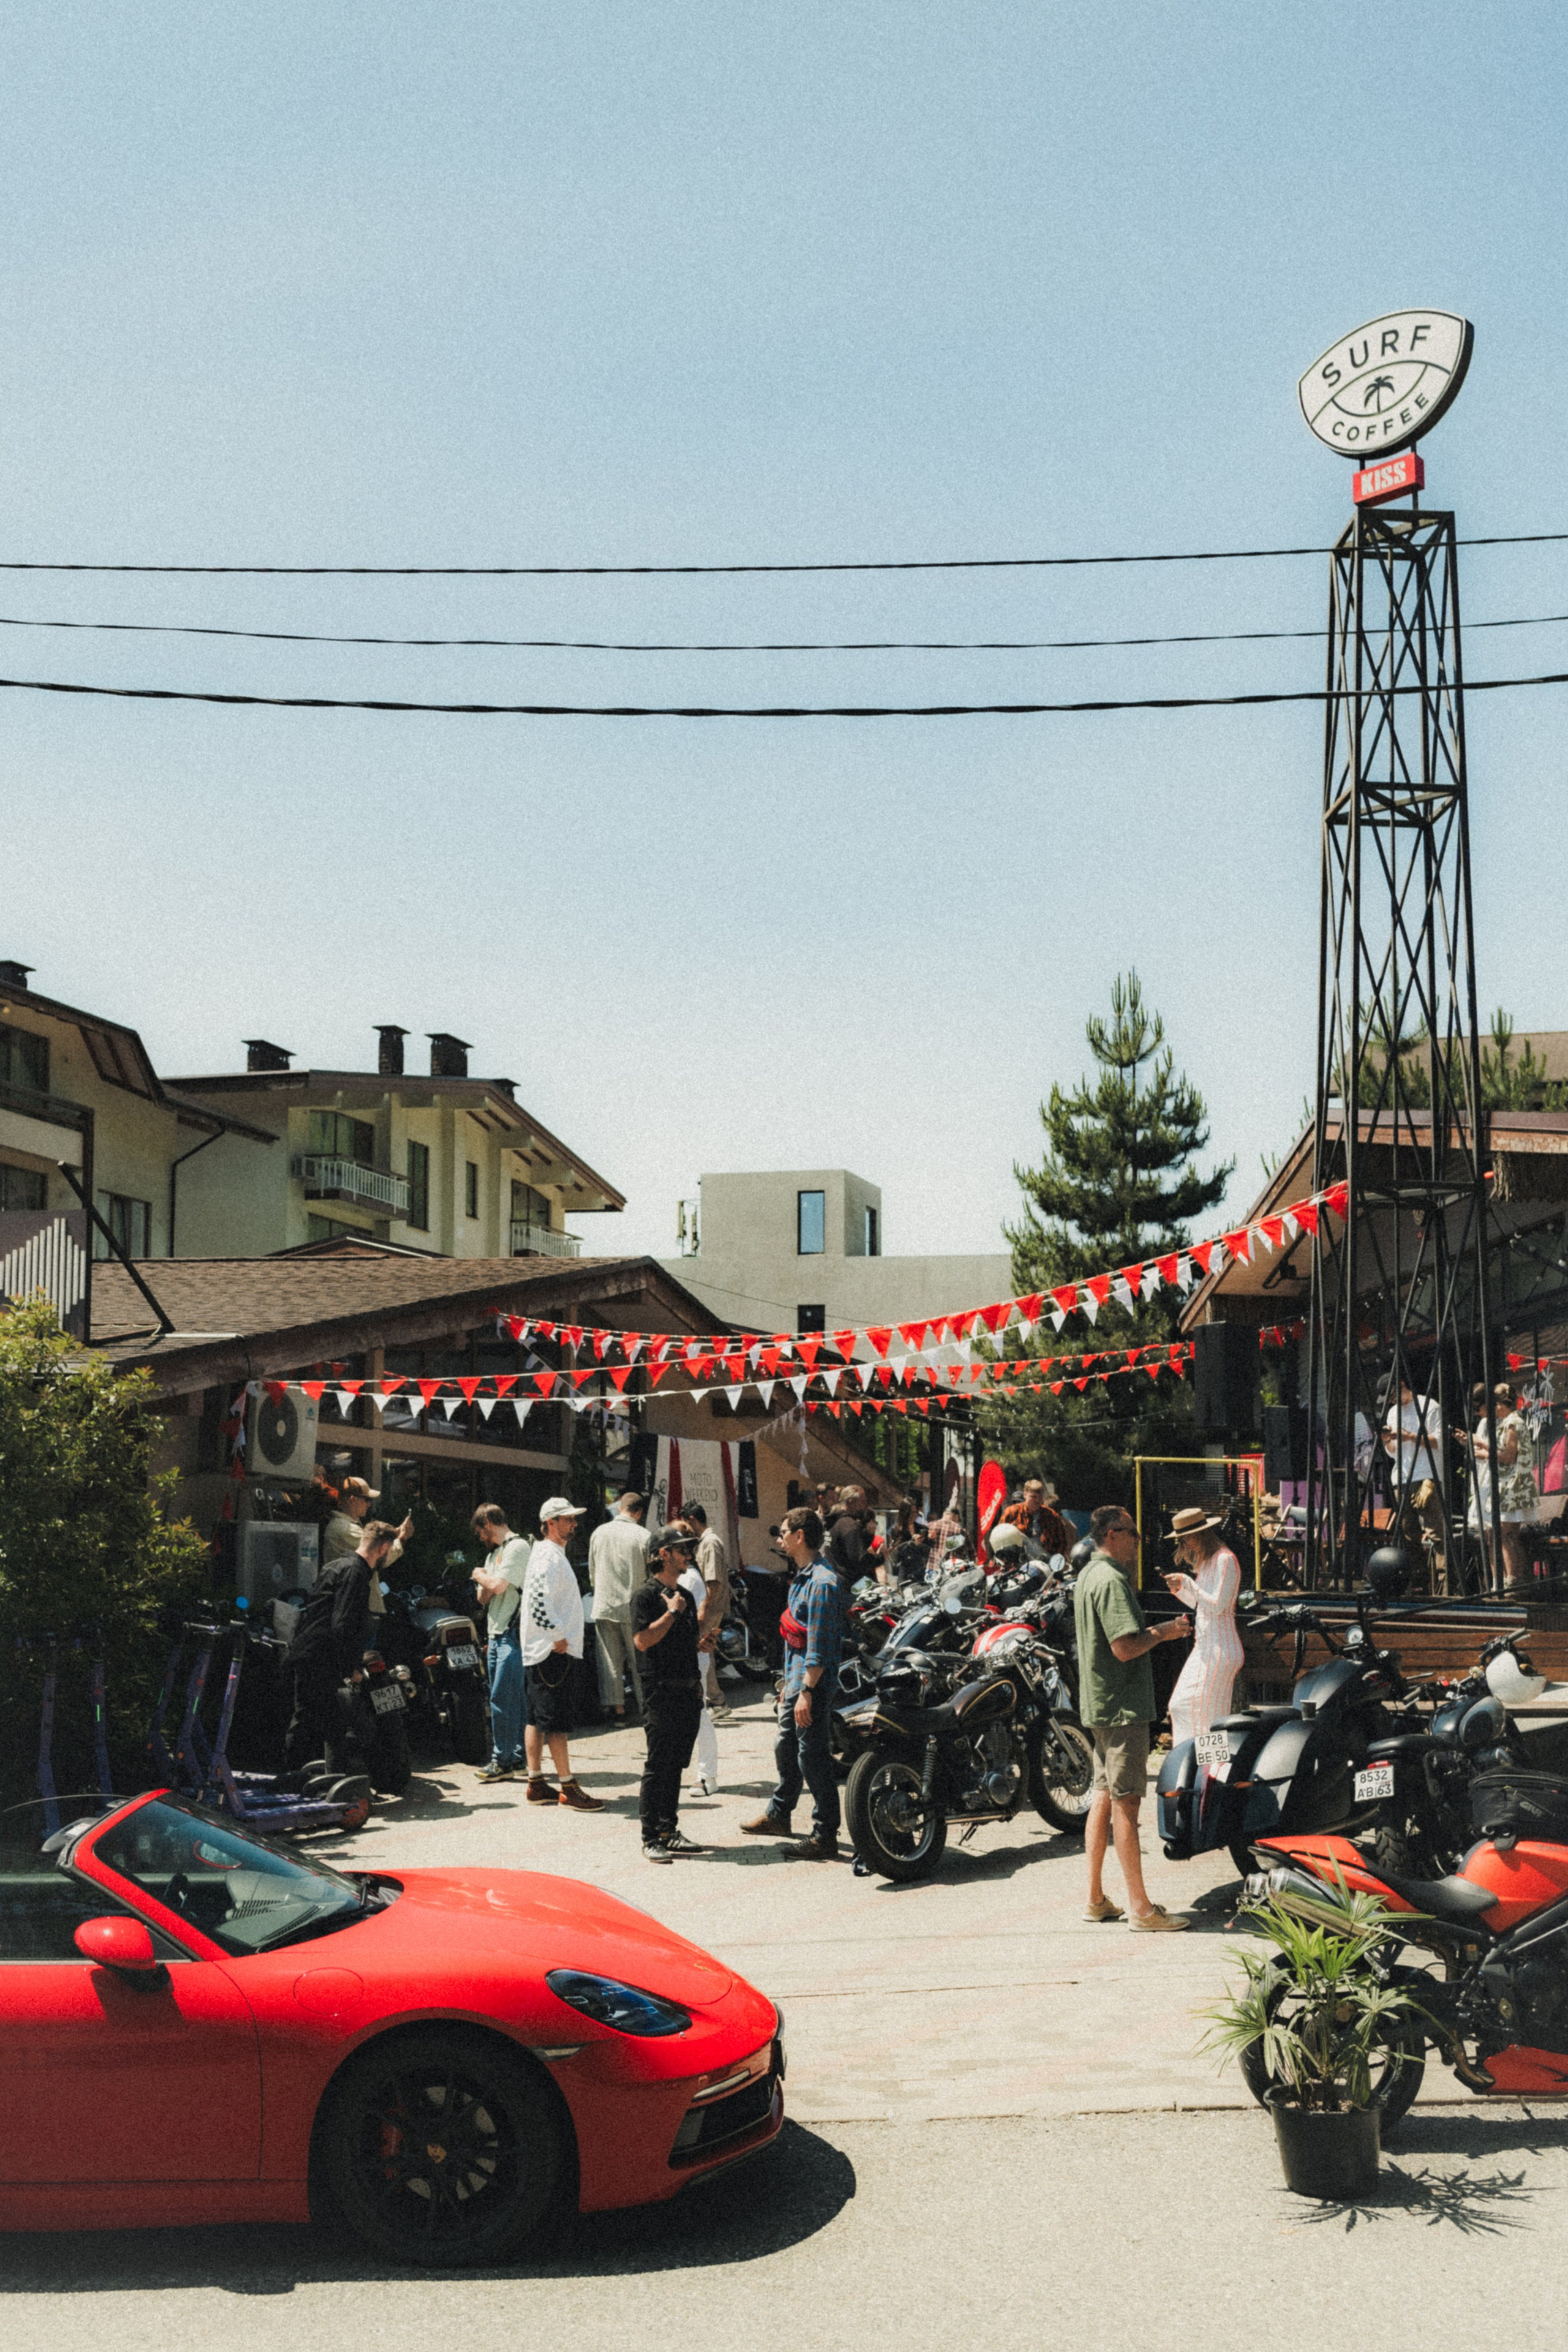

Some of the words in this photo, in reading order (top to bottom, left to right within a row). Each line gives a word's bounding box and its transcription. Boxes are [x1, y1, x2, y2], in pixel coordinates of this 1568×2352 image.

[1322, 325, 1431, 388] SURF
[1332, 393, 1429, 441] COFFEE
[1360, 461, 1407, 497] KISS
[690, 1472, 712, 1487] MOTO
[451, 1646, 472, 1655] 1862
[375, 1686, 396, 1699] 9617
[1199, 1734, 1223, 1747] 0728
[1198, 1752, 1212, 1763] BE
[1215, 1750, 1227, 1761] 50
[1360, 1770, 1388, 1784] 8532
[1357, 1787, 1374, 1798] AB
[1378, 1784, 1391, 1795] 63
